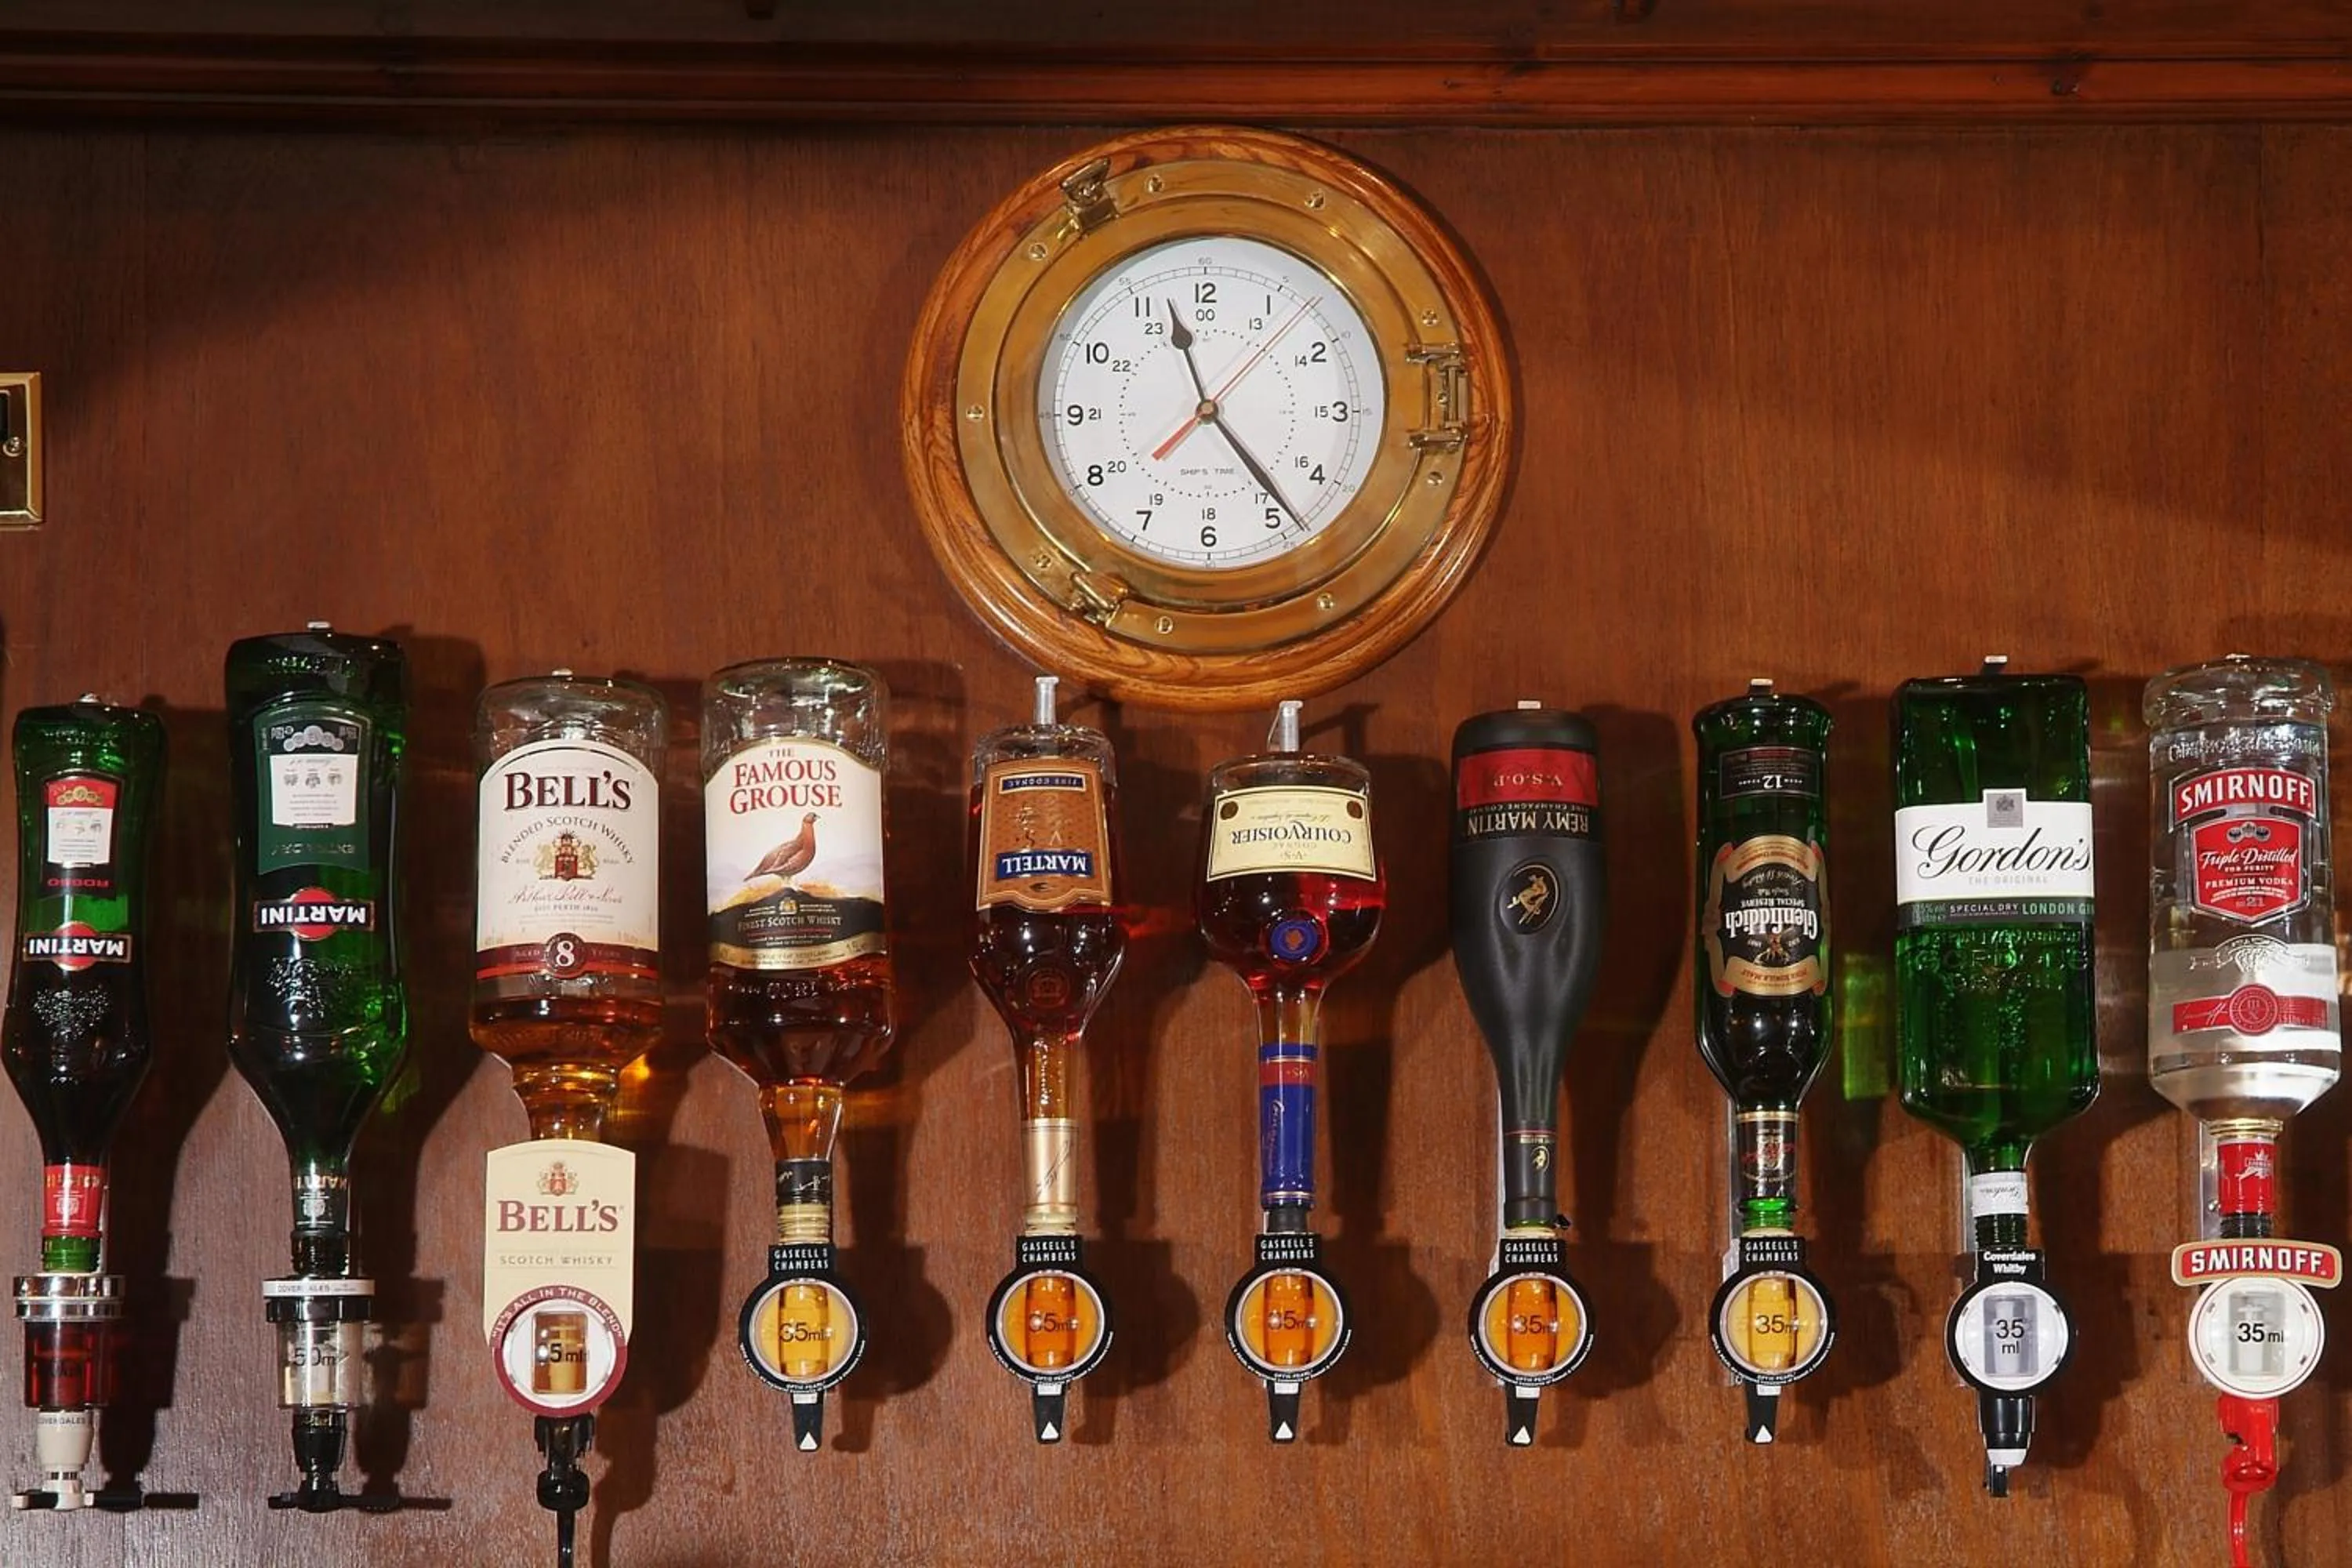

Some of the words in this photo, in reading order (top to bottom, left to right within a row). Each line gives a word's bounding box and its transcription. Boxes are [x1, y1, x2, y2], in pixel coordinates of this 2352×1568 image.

[1194, 283, 1217, 303] 12
[1135, 297, 1150, 317] 11
[1266, 296, 1271, 314] 1
[1196, 309, 1215, 321] 00
[1145, 323, 1163, 335] 23
[1250, 318, 1263, 330] 13
[1087, 343, 1109, 364] 10
[1311, 343, 1327, 362] 2
[1112, 361, 1130, 372] 22
[1295, 356, 1307, 367] 14
[1067, 405, 1083, 425] 9
[1089, 408, 1102, 419] 21
[1315, 406, 1328, 418] 15
[1332, 401, 1348, 422] 3
[1107, 462, 1126, 473] 20
[1295, 457, 1308, 468] 16
[1087, 465, 1103, 486] 8
[1309, 465, 1325, 485] 4
[1150, 494, 1163, 506] 19
[1254, 492, 1268, 503] 17
[1137, 511, 1152, 531] 7
[1203, 509, 1215, 521] 18
[1265, 509, 1280, 528] 5
[1201, 527, 1217, 547] 6
[769, 748, 795, 757] THE
[734, 760, 837, 788] FAMOUS
[1762, 775, 1782, 789] 12
[504, 771, 632, 811] BELL'S
[2181, 774, 2310, 813] SMIRNOFF
[730, 784, 843, 815] GROUSE
[1468, 811, 1537, 836] MARTIN
[502, 820, 546, 863] BLENDED
[546, 816, 597, 832] SCOTCH
[601, 826, 634, 863] WHISKY
[1232, 820, 1352, 845] COURVOISIER
[1912, 825, 2090, 879] Gordon's
[2200, 849, 2241, 870] Triple
[2241, 847, 2298, 868] Distilled
[1002, 855, 1087, 873] MARTELL
[1994, 876, 2048, 884] ORIGINAL
[2205, 877, 2256, 889] PREMIUM
[2258, 877, 2293, 886] VODKA
[261, 906, 366, 924] MARTINI
[2022, 902, 2074, 915] LONDON
[767, 915, 804, 927] SCOTCH
[1726, 907, 1818, 939] Glenfiddich
[29, 938, 124, 956] MARTINI
[555, 942, 575, 967] 8
[497, 1200, 619, 1232] BELL'S
[1022, 1241, 1067, 1252] GASKELL
[1260, 1239, 1305, 1250] GASKELL
[1505, 1242, 1549, 1253] GASKELL
[1745, 1240, 1790, 1251] GASKELL
[500, 1256, 554, 1265] SCOTCH
[561, 1256, 613, 1265] WHISKY
[774, 1249, 819, 1258] GASKELL
[1022, 1252, 1076, 1263] CHAMBERS
[1261, 1250, 1315, 1261] CHAMBERS
[1505, 1254, 1559, 1264] CHAMBERS
[1745, 1252, 1799, 1262] CHAMBERS
[1984, 1251, 2036, 1261] Coverdales
[774, 1259, 829, 1271] CHAMBERS
[2190, 1248, 2322, 1274] SMIRNOFF
[1993, 1263, 2027, 1275] Whitby
[513, 1293, 536, 1313] ALL
[539, 1287, 554, 1298] IN
[560, 1287, 584, 1300] THE
[1996, 1319, 2024, 1339] 35
[2238, 1323, 2265, 1343] 35
[2267, 1330, 2284, 1343] ml
[2002, 1341, 2020, 1354] ml
